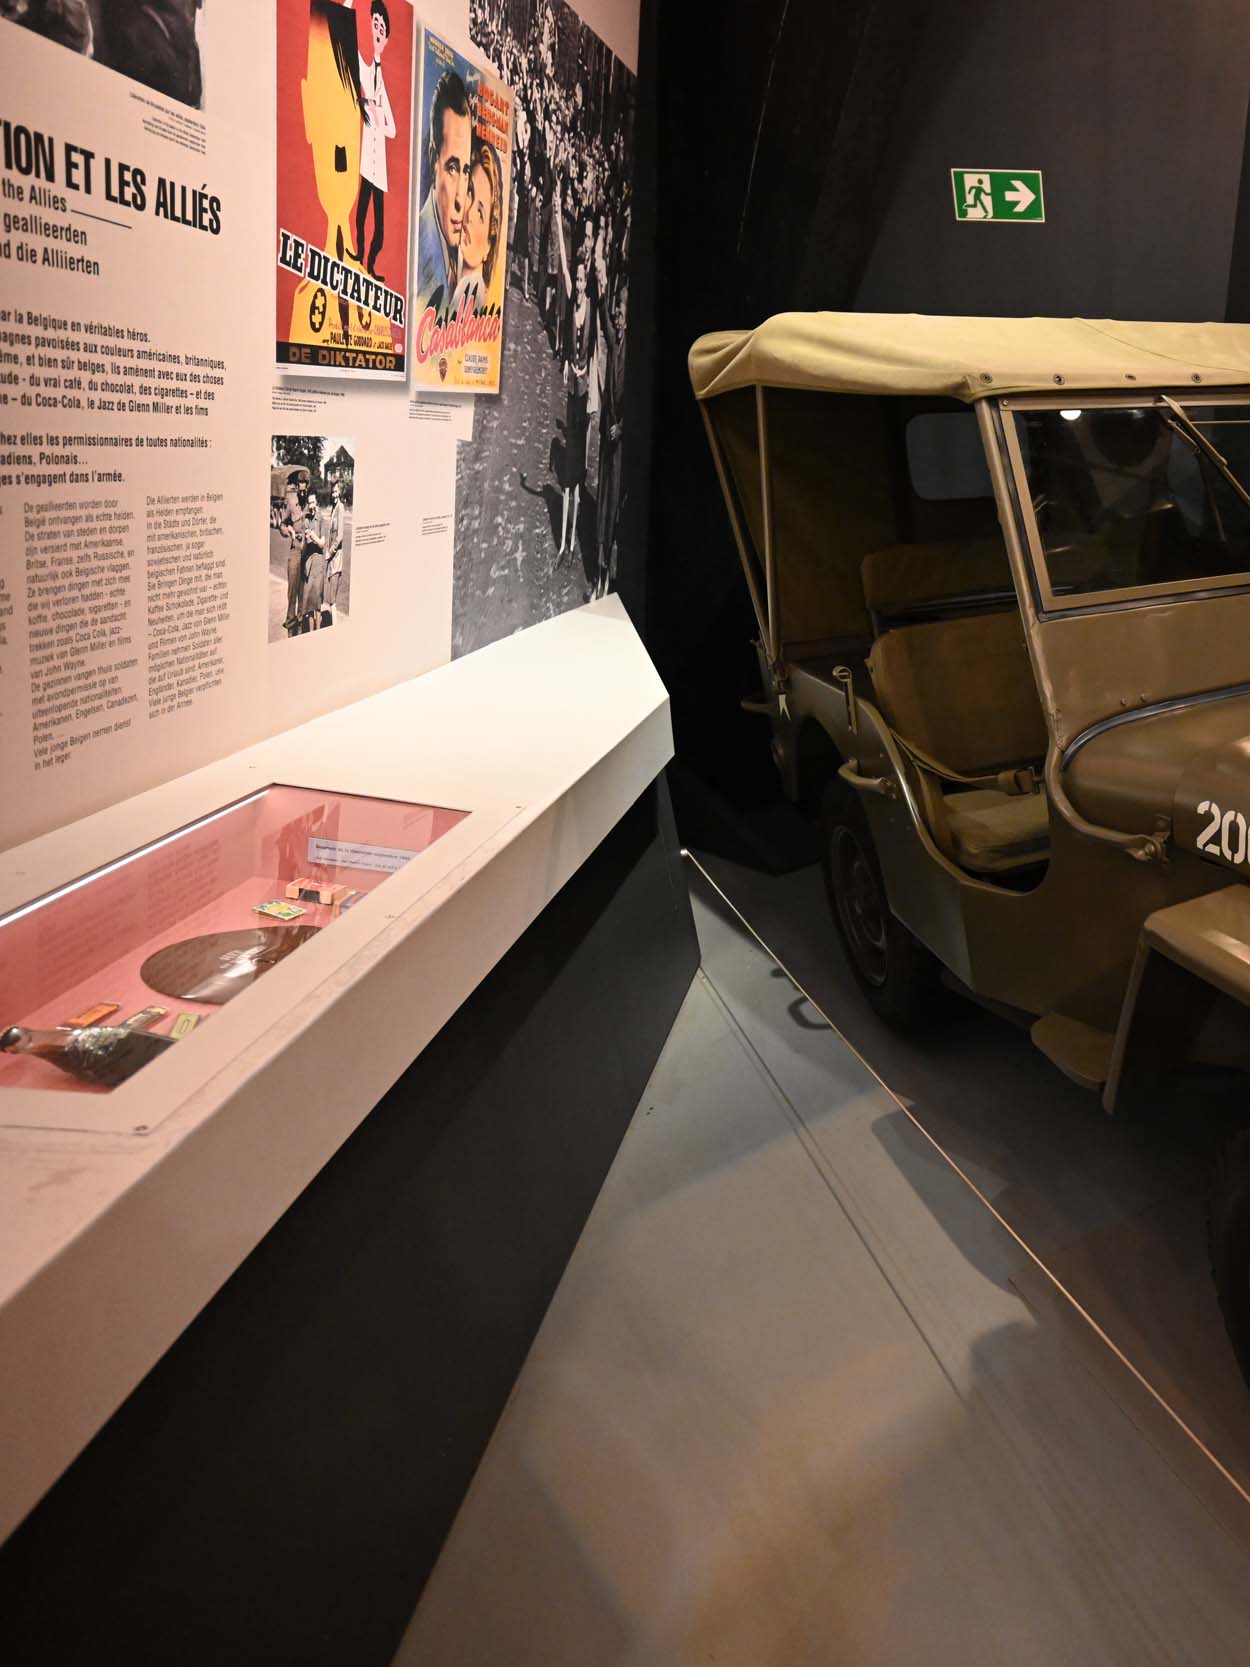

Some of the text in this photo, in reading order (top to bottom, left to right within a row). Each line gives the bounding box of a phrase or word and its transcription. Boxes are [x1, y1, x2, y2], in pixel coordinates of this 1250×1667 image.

[0, 118, 221, 235] ION ET LES ALLIÉS
[2, 178, 67, 213] the Allies
[4, 212, 88, 246] geallieerden
[16, 242, 37, 264] die
[42, 247, 100, 276] Alliierten
[280, 231, 404, 325] LE DICTATEUR
[14, 311, 24, 324] la
[27, 311, 68, 332] Belgique
[70, 320, 82, 332] en
[84, 321, 125, 339] véritables
[126, 327, 151, 342] héros.
[416, 293, 501, 363] Casablanca
[26, 353, 35, 366] et
[38, 354, 58, 369] bien
[61, 356, 75, 371] sûr
[77, 361, 108, 376] belges,
[123, 365, 155, 378] amènent
[157, 371, 174, 381] avec
[175, 372, 188, 382] eux
[189, 371, 201, 383] des
[202, 373, 224, 385] choses
[35, 334, 81, 352] pavoisées
[83, 341, 98, 353] aux
[100, 343, 134, 358] couleurs
[136, 347, 183, 366] américaines,
[184, 353, 227, 371] britanniques,
[289, 347, 396, 370] DE DIKTATOR
[20, 393, 32, 406] du
[35, 393, 84, 410] Coca-Cola,
[87, 398, 95, 409] le
[97, 398, 114, 411] Jazz
[117, 399, 126, 411] de
[129, 399, 150, 412] Glenn
[152, 400, 173, 415] Miller
[175, 403, 182, 414] et
[183, 403, 193, 415] les
[29, 374, 40, 387] du
[43, 375, 61, 389] vrai
[64, 376, 84, 391] café,
[88, 379, 98, 391] du
[101, 381, 137, 396] chocolat,
[139, 384, 152, 395] des
[154, 385, 188, 401] cigarettes
[196, 390, 203, 400] et
[204, 389, 214, 400] des
[20, 432, 43, 446] elles
[46, 432, 59, 446] les
[62, 433, 133, 449] permissionnaires
[135, 435, 144, 447] de
[146, 436, 167, 448] toutes
[170, 435, 208, 448] nationalités
[16, 471, 66, 488] s'engagent
[69, 470, 89, 483] dans
[91, 471, 125, 483] l'armée.
